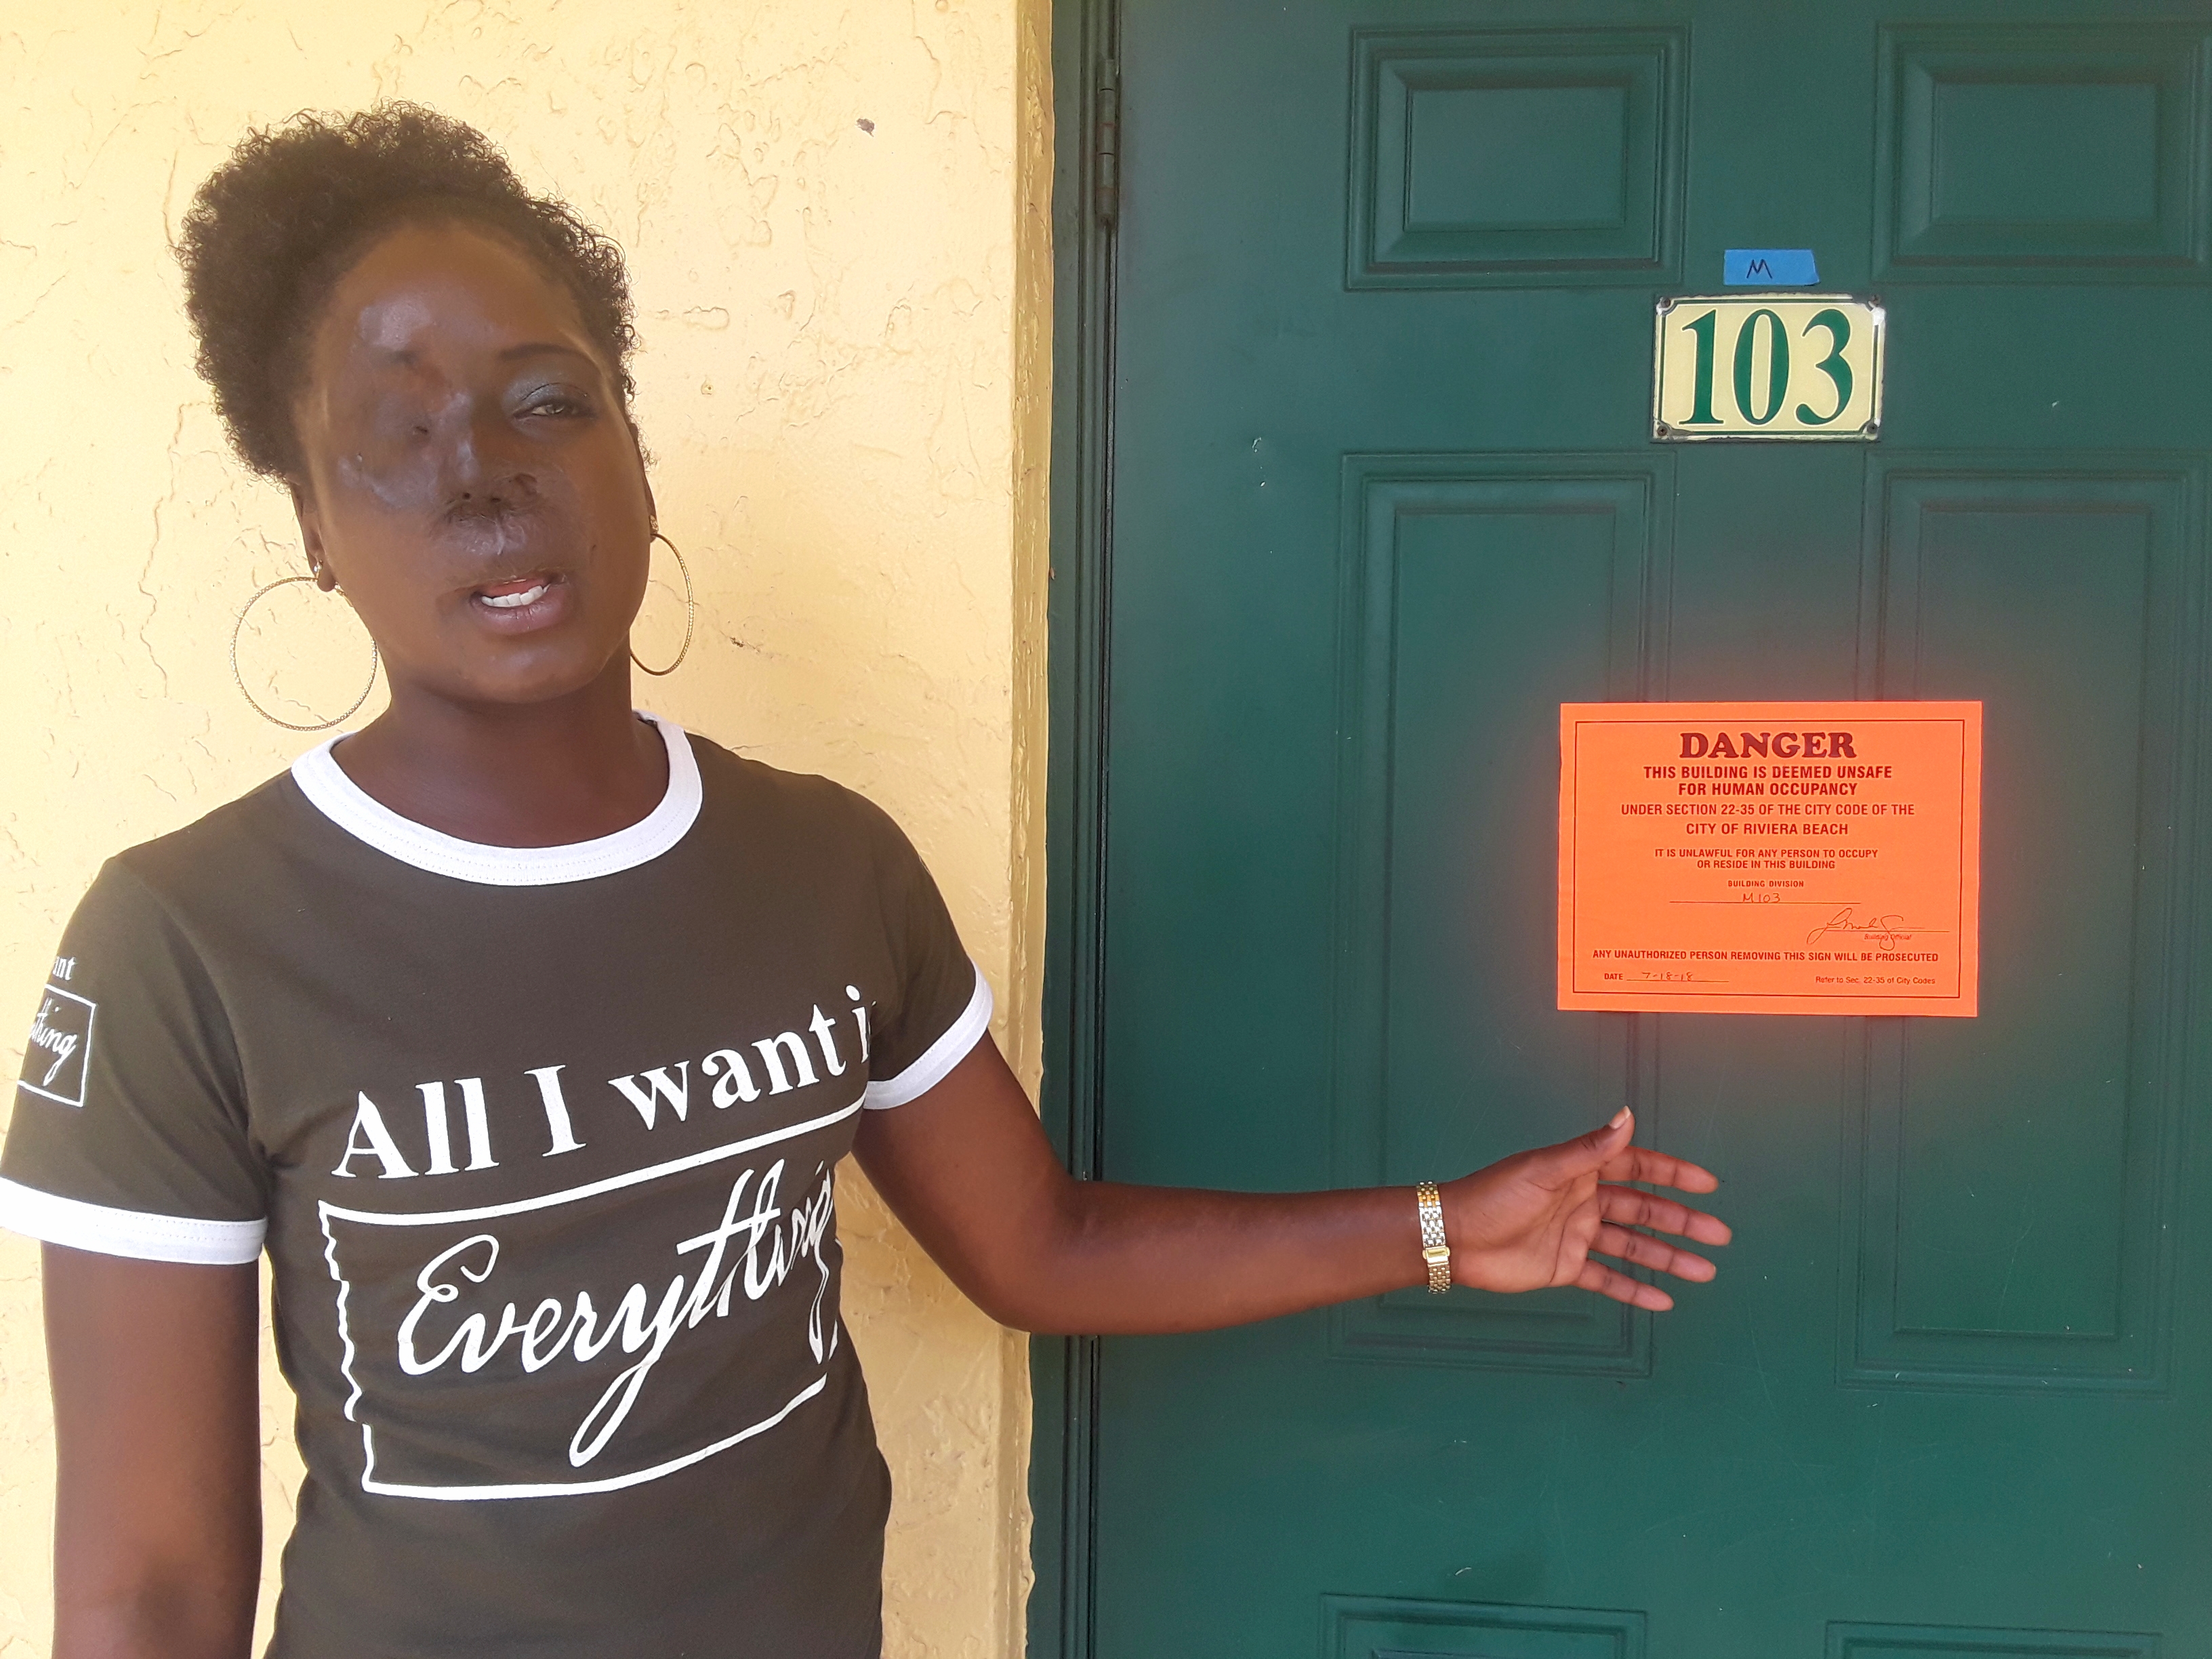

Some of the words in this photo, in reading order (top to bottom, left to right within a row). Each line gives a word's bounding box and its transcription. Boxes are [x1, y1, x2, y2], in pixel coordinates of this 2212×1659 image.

[1746, 258, 1773, 279] M
[1677, 308, 1856, 426] 103
[1679, 731, 1858, 759] DANGER
[1643, 766, 1676, 779] THIS
[1681, 766, 1748, 779] BUILDING
[1753, 766, 1767, 779] IS
[1771, 765, 1832, 779] DEEMED
[1837, 765, 1892, 779] UNSAFE
[1678, 783, 1706, 796] FOR
[1712, 782, 1765, 796] HUMAN
[1769, 782, 1858, 796] OCCUPANCY
[1621, 804, 1662, 815] UNDER
[1666, 804, 1717, 815] SECTION
[1721, 804, 1755, 815] 22-35
[1759, 804, 1774, 815] OF
[1777, 804, 1801, 815] THE
[1805, 804, 1832, 815] CITY
[1835, 804, 1868, 815] CODE
[1872, 804, 1887, 815] OF
[1891, 804, 1915, 815] THE
[1686, 823, 1717, 835] CITY
[1721, 823, 1739, 835] OF
[1743, 823, 1798, 835] RIVIERA
[1803, 823, 1848, 835] BEACH
[1655, 848, 1664, 857] IT
[1666, 848, 1676, 857] IS
[1679, 848, 1733, 858] UNLAWFUL
[1736, 848, 1755, 858] FOR
[1757, 848, 1778, 858] ANY
[1780, 849, 1820, 858] PERSON
[1822, 849, 1836, 859] TO
[1839, 849, 1879, 859] OCCUPY
[1697, 859, 1711, 869] OR
[1713, 859, 1748, 869] RESIDE
[1750, 859, 1761, 869] IN
[1763, 860, 1786, 869] THIS
[1789, 859, 1835, 869] BUILDING
[1769, 880, 1804, 888] DIVISION
[1593, 949, 1612, 959] ANY
[1614, 949, 1687, 960] UNAUTHORIZED
[1689, 951, 1728, 960] PERSON
[1730, 951, 1781, 960] REMOVING
[1783, 951, 1805, 961] THIS
[1808, 952, 1830, 961] SIGN
[1834, 952, 1858, 961] WILL
[1861, 952, 1872, 962] BE
[1875, 953, 1939, 962] PROSECUTED
[1641, 972, 1694, 981] 7-18-18
[1816, 976, 1835, 984] Refer
[1896, 977, 1911, 986] City
[331, 1077, 500, 1179] All
[523, 1064, 587, 1158] I
[608, 1003, 847, 1130] want
